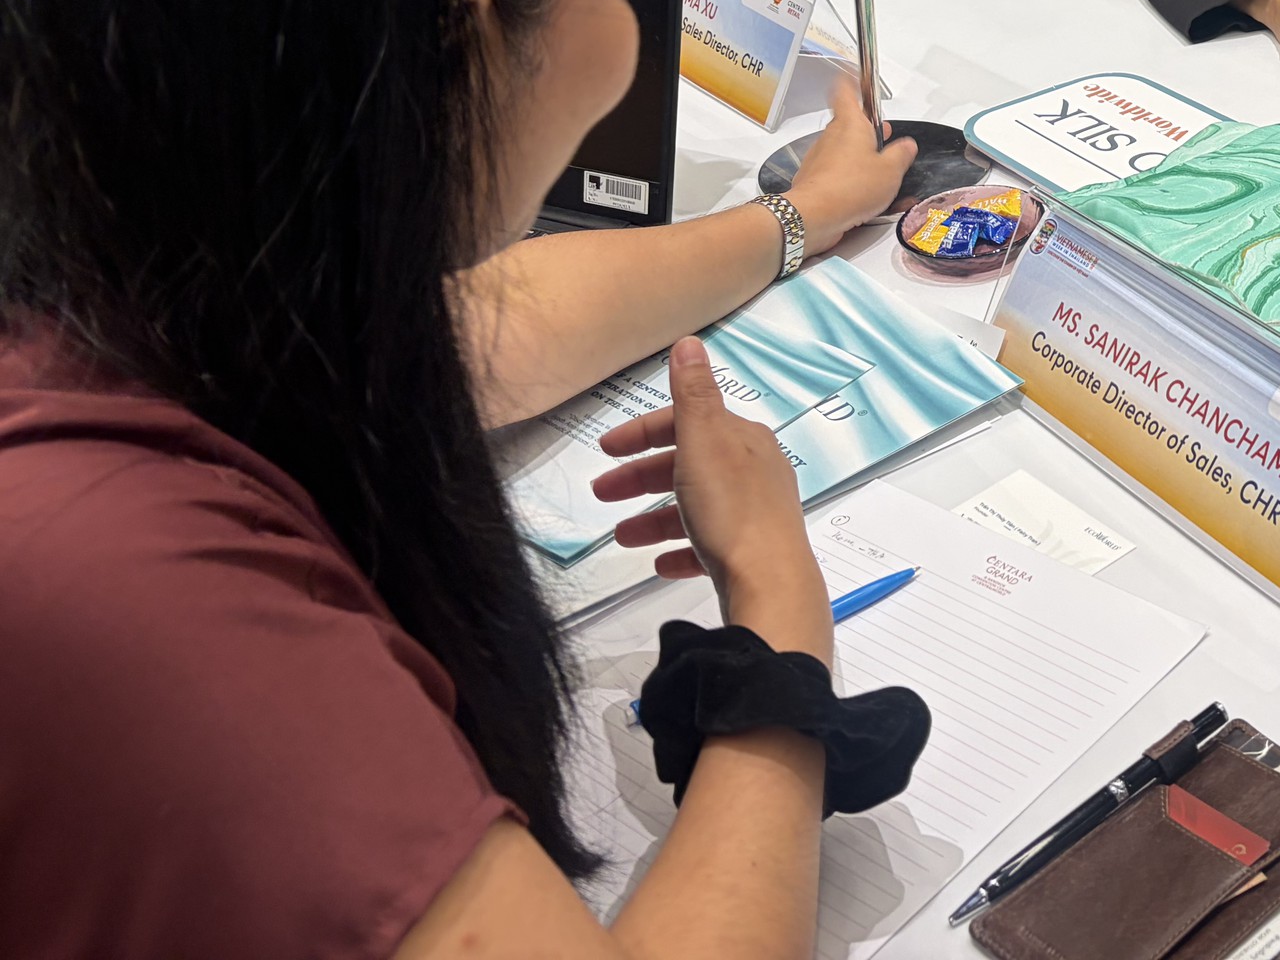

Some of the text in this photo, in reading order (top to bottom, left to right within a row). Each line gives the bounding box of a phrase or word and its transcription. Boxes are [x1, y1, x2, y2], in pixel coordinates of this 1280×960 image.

[701, 0, 718, 20] XU
[681, 17, 764, 77] Sales Director, CHR
[1033, 98, 1137, 152] SILK
[1083, 83, 1189, 142] Worldwide
[1057, 235, 1094, 262] VIETNAMESE
[1052, 302, 1082, 337] MS.
[1084, 324, 1168, 393] SANIRAK
[591, 390, 642, 420] ON THE GLO
[1031, 331, 1101, 394] Corporate
[1102, 381, 1166, 440] Director
[1167, 433, 1189, 454] of
[1185, 442, 1233, 495] Sales,
[985, 566, 1019, 585] GRAND
[986, 555, 1033, 582] CENTARA
